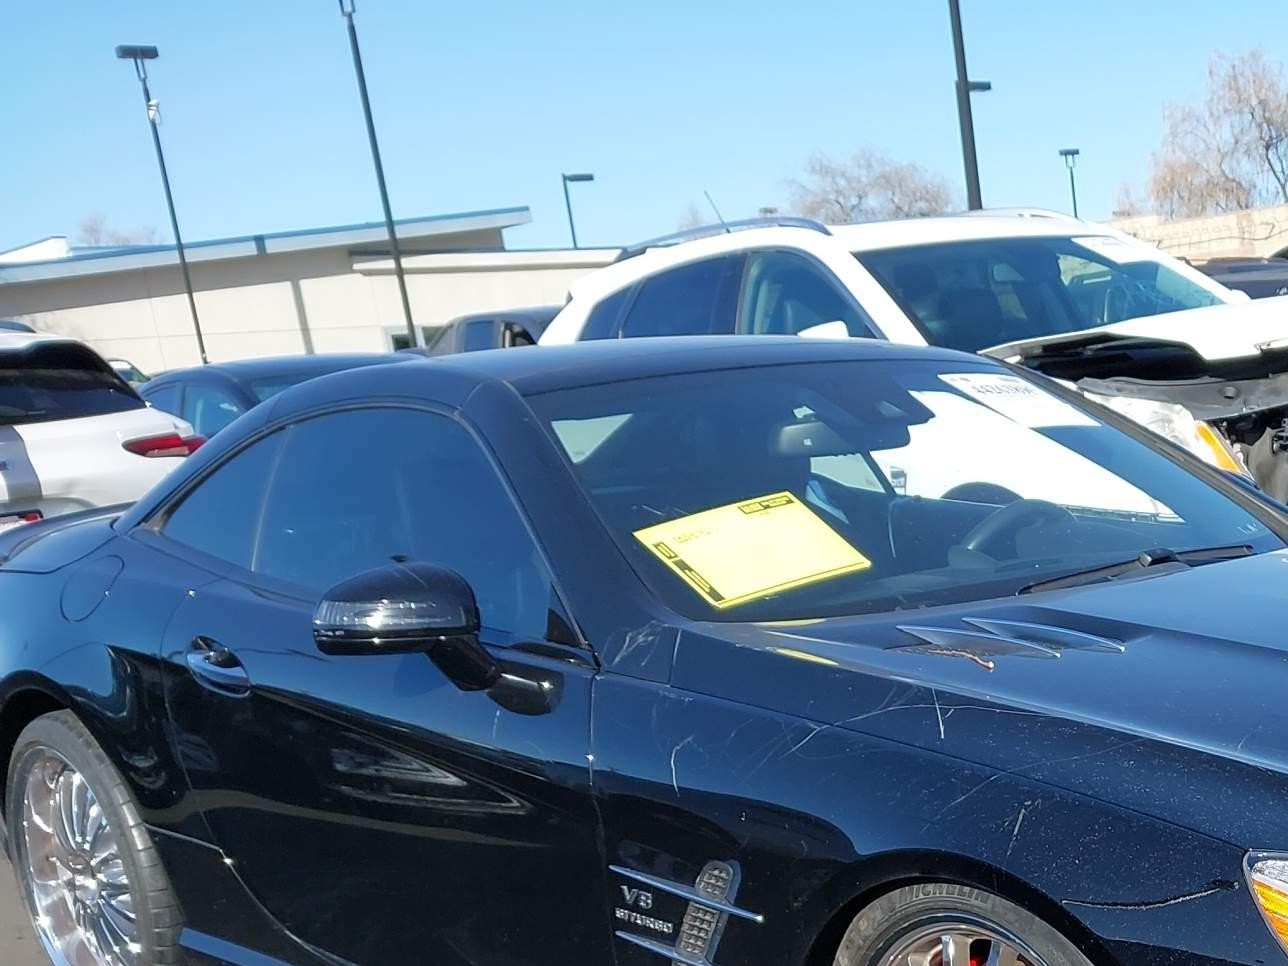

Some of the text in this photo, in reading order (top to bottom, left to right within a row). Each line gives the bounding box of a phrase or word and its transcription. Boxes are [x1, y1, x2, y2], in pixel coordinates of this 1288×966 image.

[619, 884, 653, 910] V8
[901, 882, 990, 906] MICHELIN
[614, 907, 674, 934] BITURBO
